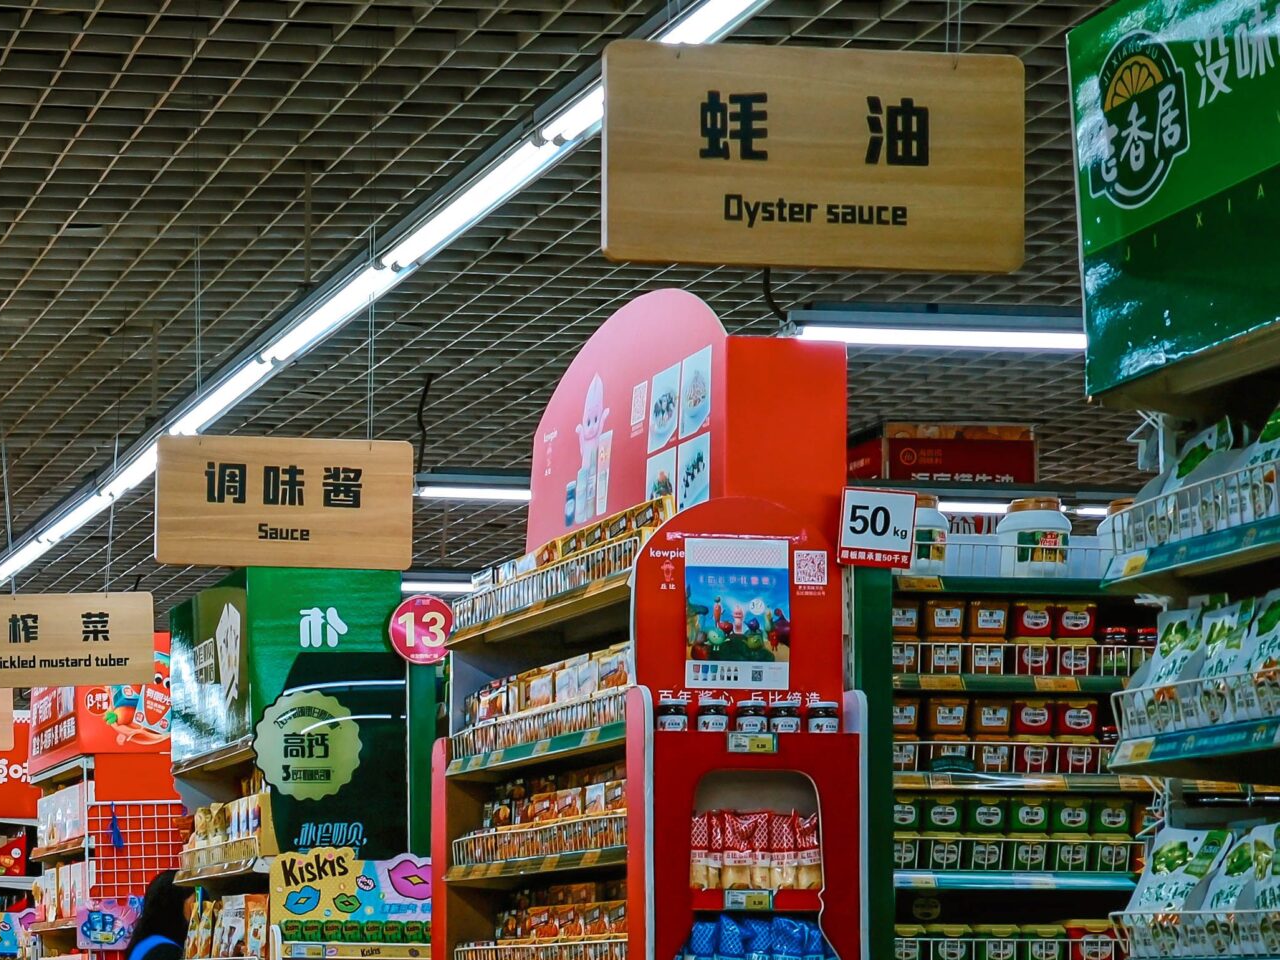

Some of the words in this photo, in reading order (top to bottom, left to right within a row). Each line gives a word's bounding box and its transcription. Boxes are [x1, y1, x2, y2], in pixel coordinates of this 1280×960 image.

[1193, 8, 1280, 109] 没味
[699, 90, 929, 166] 蚝油
[725, 193, 817, 227] Oyster
[826, 205, 907, 226] sauce
[205, 462, 363, 509] 调味酱
[258, 523, 310, 541] Sauce
[850, 504, 890, 536] 50
[893, 526, 907, 539] kg
[649, 548, 685, 559] kewpie
[9, 611, 111, 644] 榨菜
[299, 606, 348, 648] 朴
[397, 612, 446, 648] 13
[40, 654, 92, 669] mustard
[95, 654, 130, 668] tuber
[283, 733, 329, 758] 高钙
[281, 853, 349, 887] Kiskis
